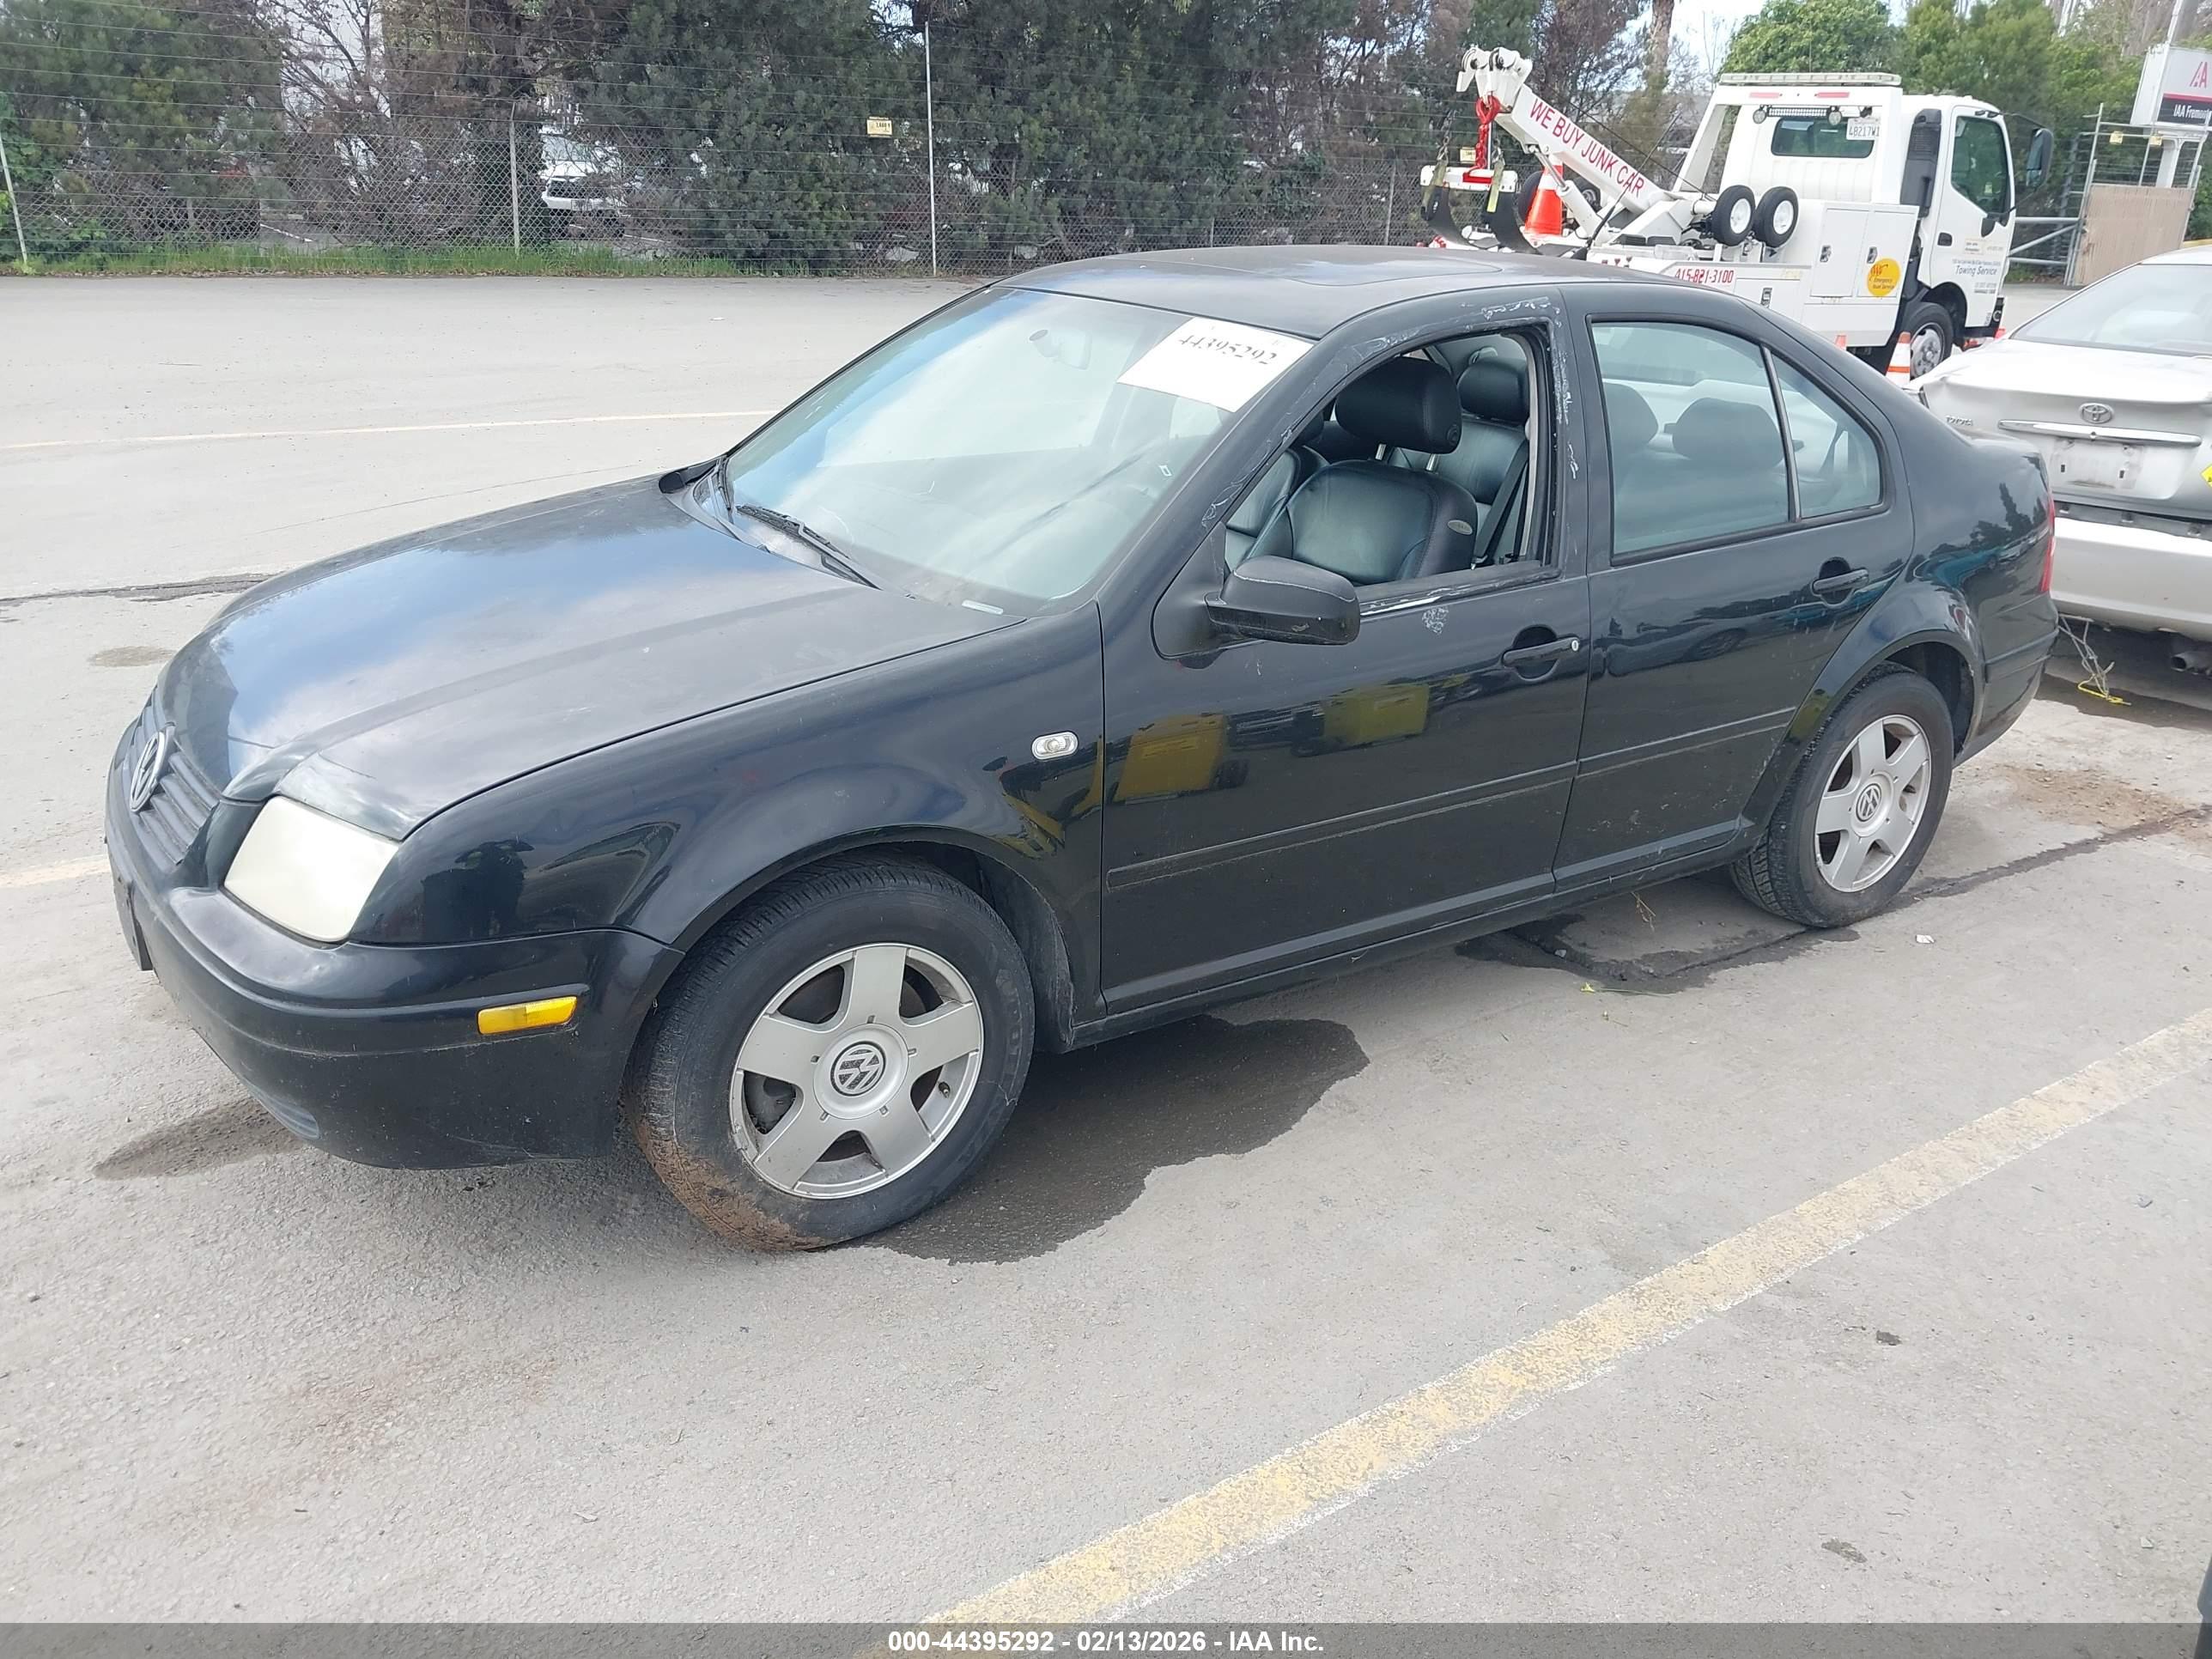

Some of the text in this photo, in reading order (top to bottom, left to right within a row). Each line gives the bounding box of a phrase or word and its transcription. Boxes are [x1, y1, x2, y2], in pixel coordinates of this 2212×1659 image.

[2173, 104, 2185, 117] IAA
[1530, 98, 1645, 198] WE BUY JUNK CAR
[1675, 268, 1735, 284] 415-821-3100
[1955, 264, 1998, 277] Towing Service
[1178, 335, 1278, 364] 44395292
